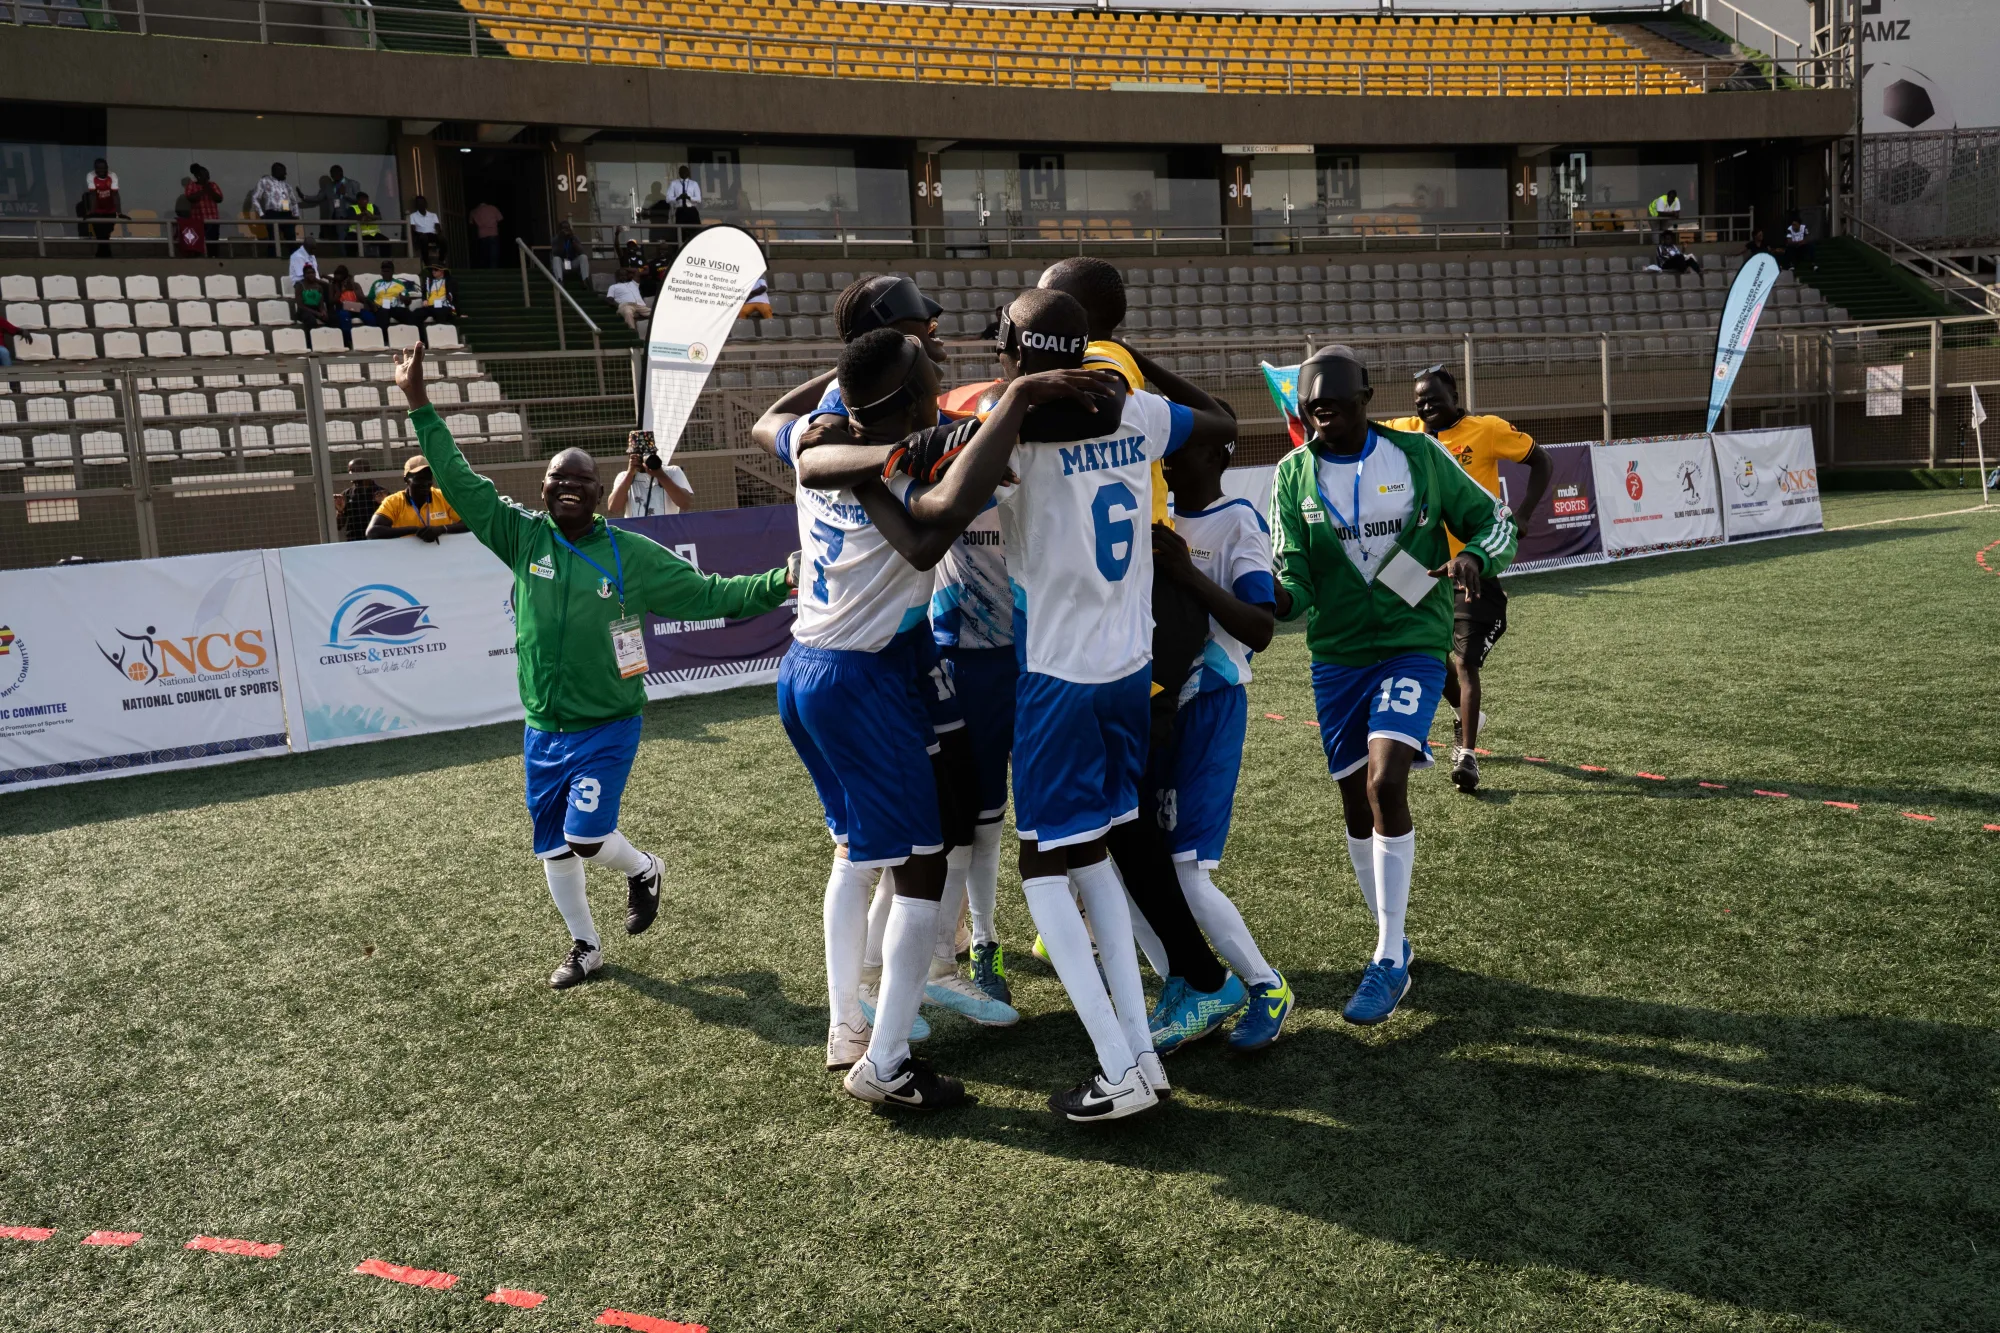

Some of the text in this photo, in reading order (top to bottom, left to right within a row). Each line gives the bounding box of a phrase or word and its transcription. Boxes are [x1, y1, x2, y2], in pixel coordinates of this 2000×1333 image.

[1862, 20, 1911, 42] AMZ
[686, 256, 740, 272] OUR VISION
[671, 277, 704, 287] Excellence
[709, 274, 728, 283] Centre
[667, 285, 707, 296] Reproductive
[674, 294, 694, 302] Health
[1733, 288, 1755, 332] SPECIALIZED
[1752, 261, 1765, 287] WOMEN
[1726, 350, 1734, 365] AND
[1059, 435, 1146, 476] MAYIIK
[1786, 468, 1817, 491] NCS
[1557, 485, 1578, 497] multi
[1554, 500, 1586, 512] SPORTS
[1090, 482, 1138, 582] 6
[1364, 518, 1401, 537] SUDAN
[962, 530, 999, 546] SOUTH
[809, 518, 845, 605] 7
[1191, 549, 1210, 557] LIGHT
[654, 617, 725, 636] HAMZ STADIUM
[15, 639, 29, 683] COMMITTEE
[153, 629, 267, 678] NCS
[319, 642, 447, 666] CRUISES & EVENTS LTD
[488, 648, 508, 657] SIMPLE
[159, 667, 270, 687] National Council of Sports
[122, 680, 279, 711] NATIONAL COUNCIL OF SPORTS
[1377, 676, 1422, 716] 13
[12, 702, 68, 718] COMMITTEE
[5, 722, 36, 731] Promotion
[44, 719, 65, 727] Sports
[22, 727, 45, 736] Uganda
[575, 777, 602, 813] 3
